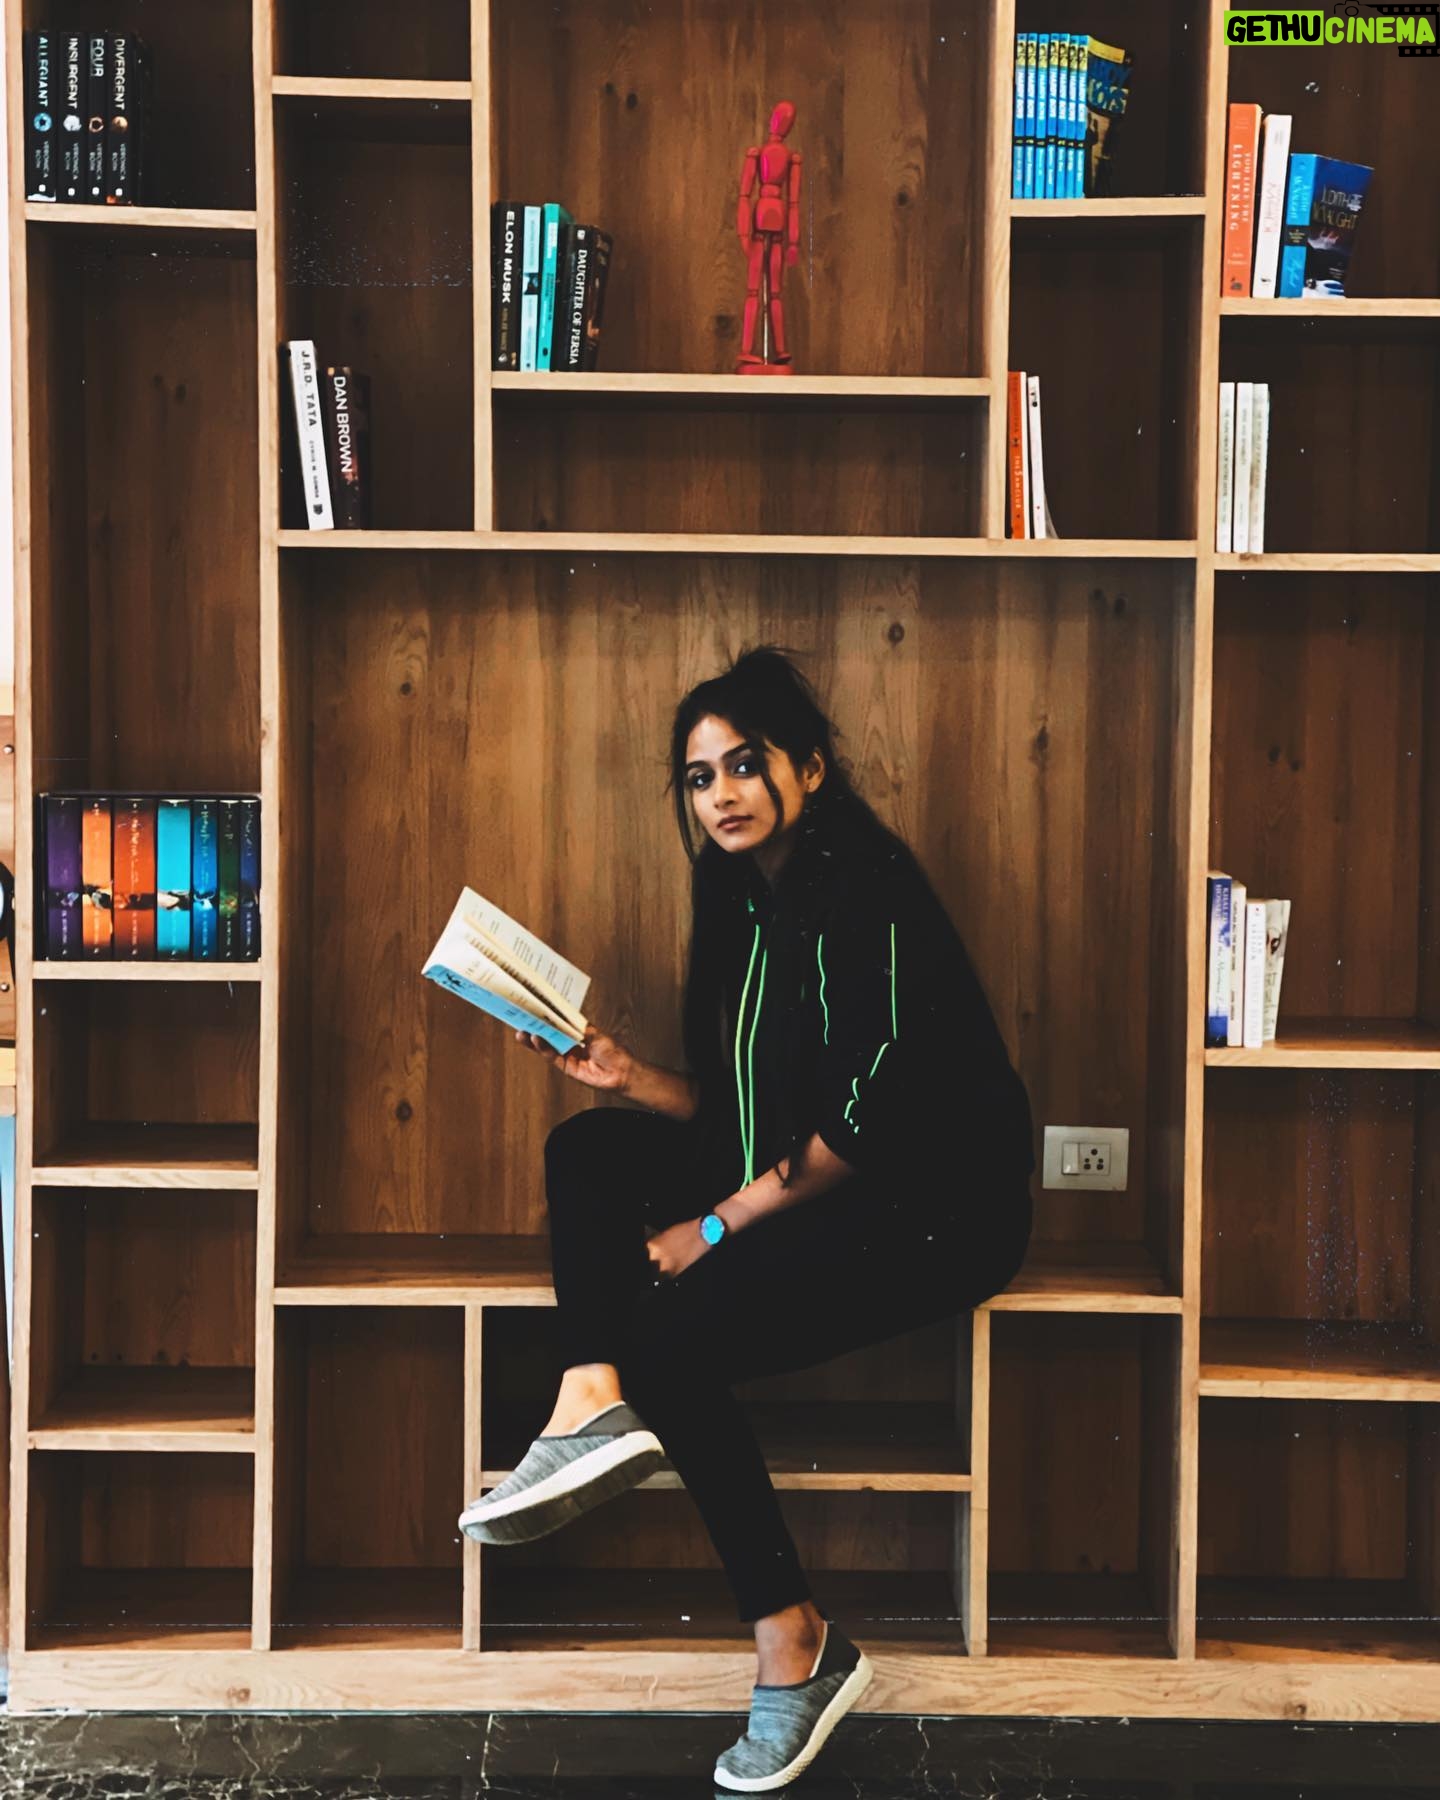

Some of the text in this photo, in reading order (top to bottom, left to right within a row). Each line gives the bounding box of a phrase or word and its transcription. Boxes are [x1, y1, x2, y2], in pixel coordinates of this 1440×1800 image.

[92, 38, 105, 77] FOUR
[114, 38, 126, 110] DIVERGENT
[1229, 144, 1243, 231] LIGHTNING
[502, 211, 515, 303] ELON MUSK
[569, 249, 587, 365] DAUGHTER OF PERSIA
[306, 394, 317, 426] TATA
[333, 376, 353, 473] DAN BROWN
